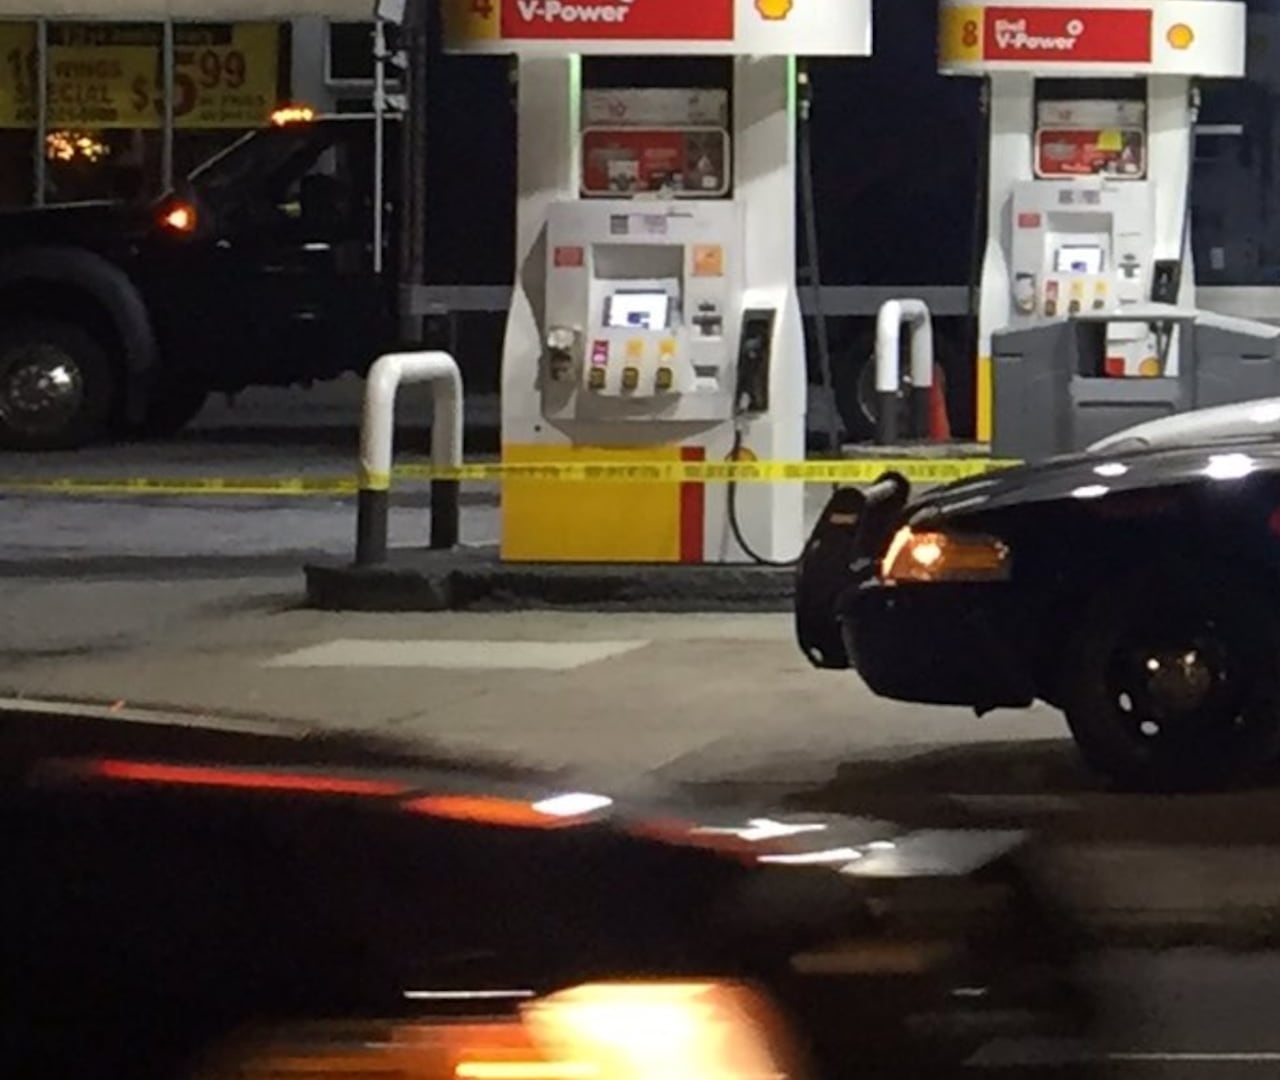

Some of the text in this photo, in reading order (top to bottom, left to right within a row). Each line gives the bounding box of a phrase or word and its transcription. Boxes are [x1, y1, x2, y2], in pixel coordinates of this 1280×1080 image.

[517, 0, 630, 22] V-Power
[962, 19, 979, 48] 8
[996, 31, 1077, 51] V-Power
